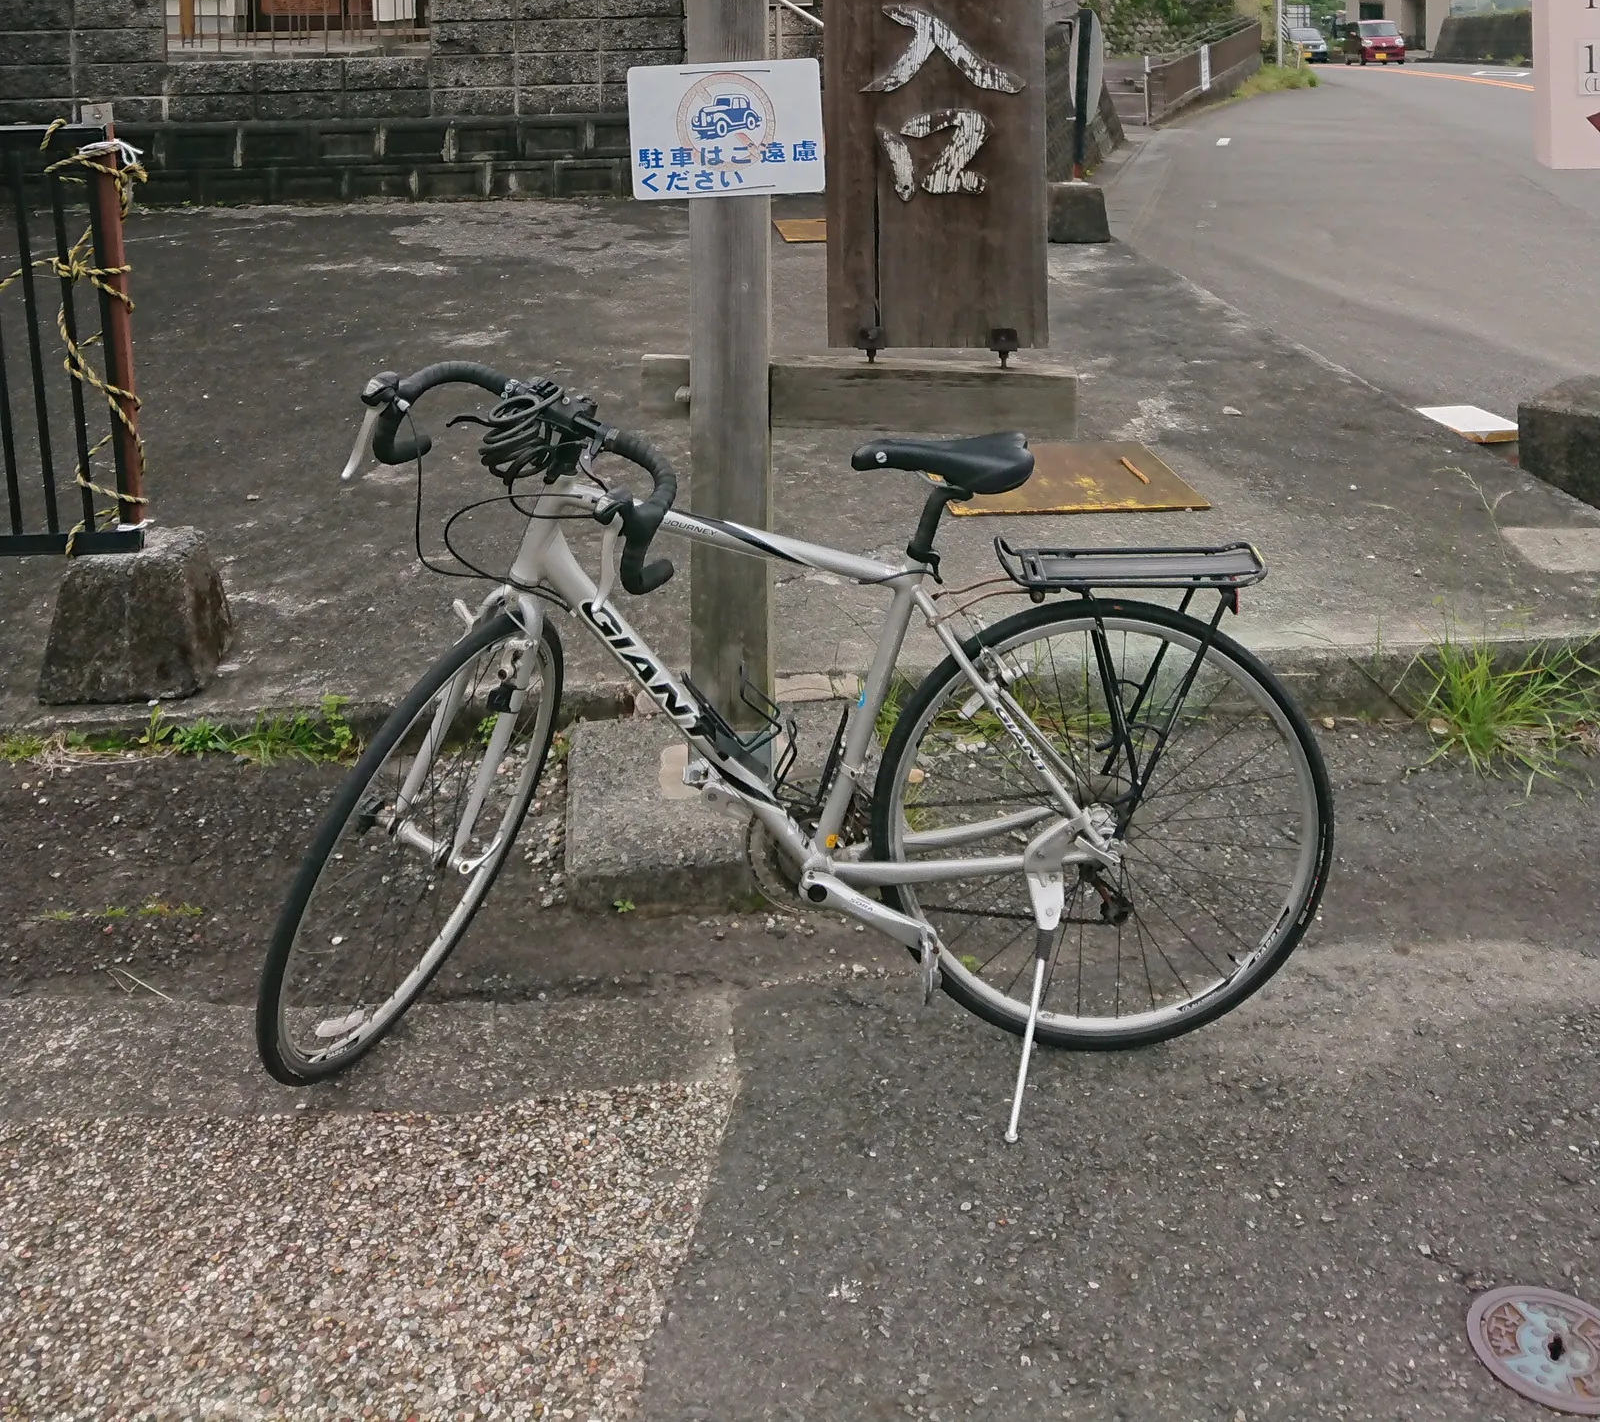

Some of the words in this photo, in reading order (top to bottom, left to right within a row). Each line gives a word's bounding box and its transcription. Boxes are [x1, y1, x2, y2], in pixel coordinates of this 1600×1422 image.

[638, 140, 819, 170] 駐車はご遠慮
[641, 170, 744, 193] ください
[663, 519, 718, 536] JOURNEY
[995, 706, 1051, 776] GIANT
